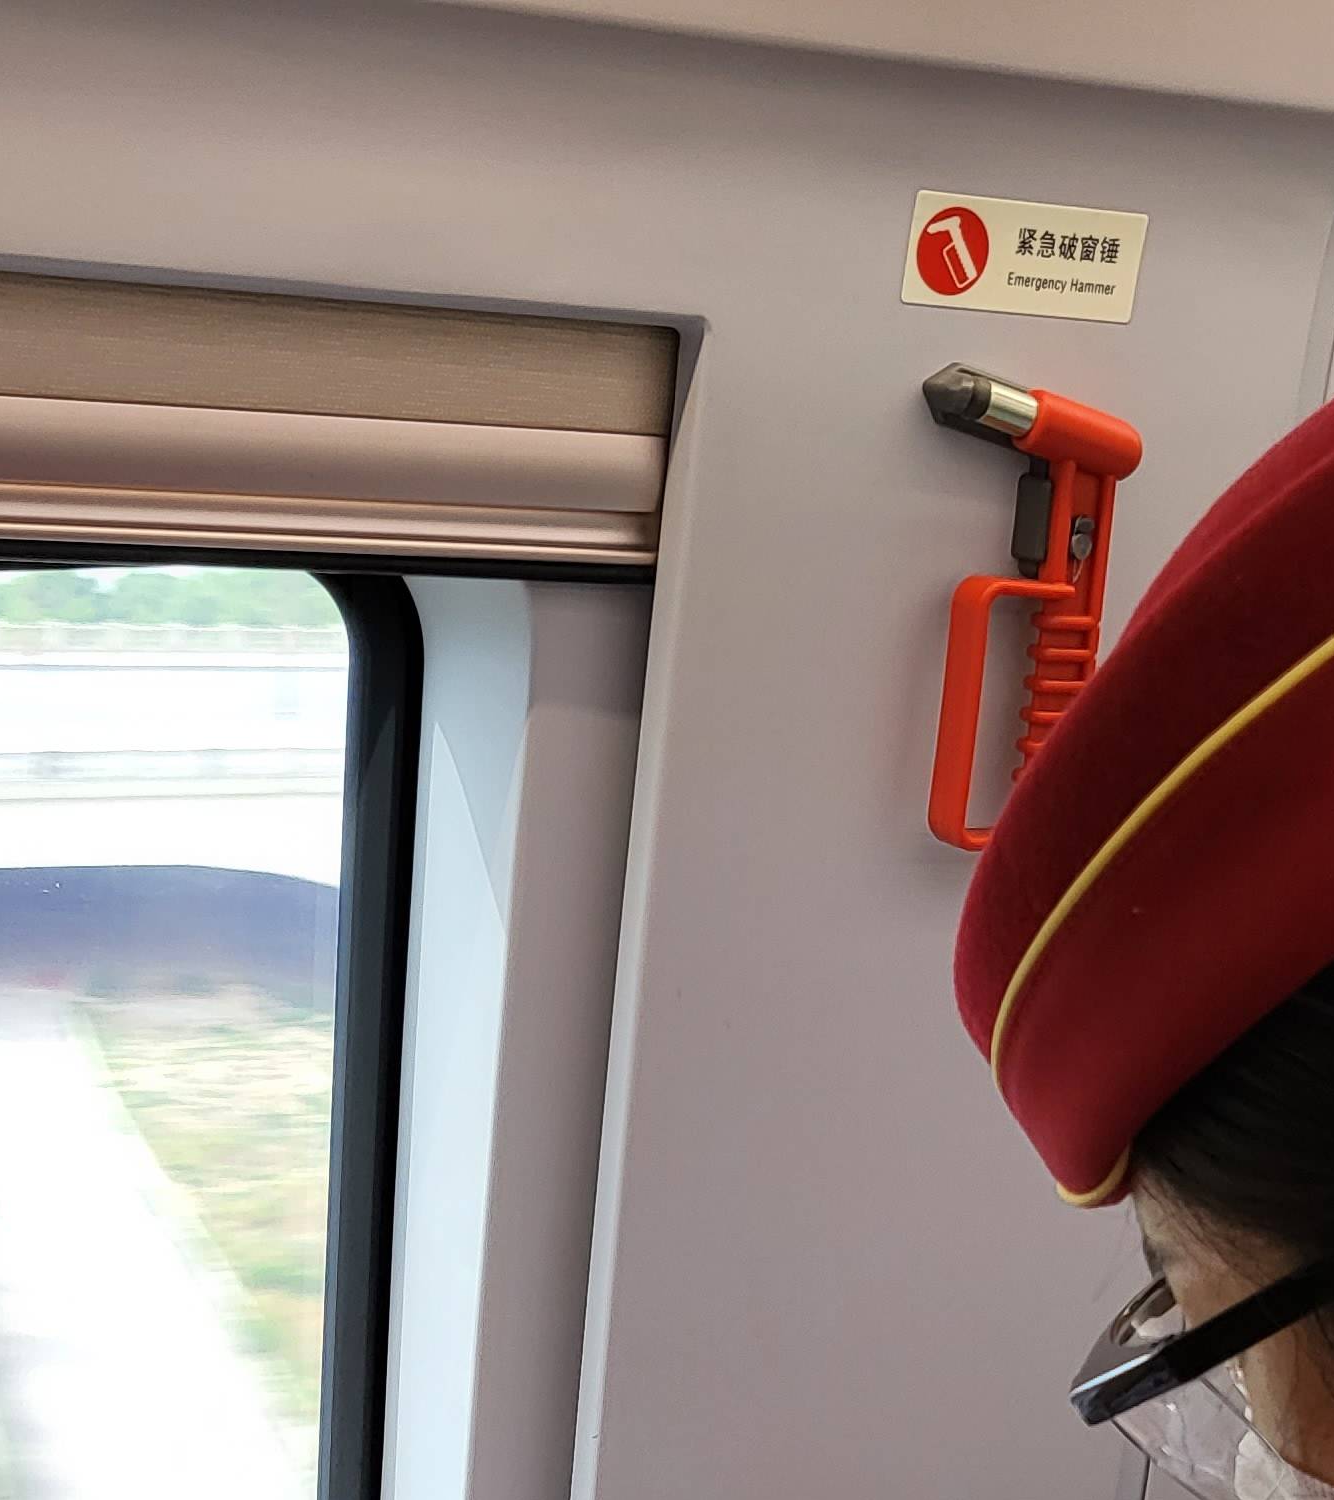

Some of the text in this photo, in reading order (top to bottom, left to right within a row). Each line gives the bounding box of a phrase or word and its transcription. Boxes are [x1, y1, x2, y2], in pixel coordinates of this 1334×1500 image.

[1015, 227, 1121, 265] 紧急破窗锤
[1007, 272, 1116, 296] Emergency Hammer
